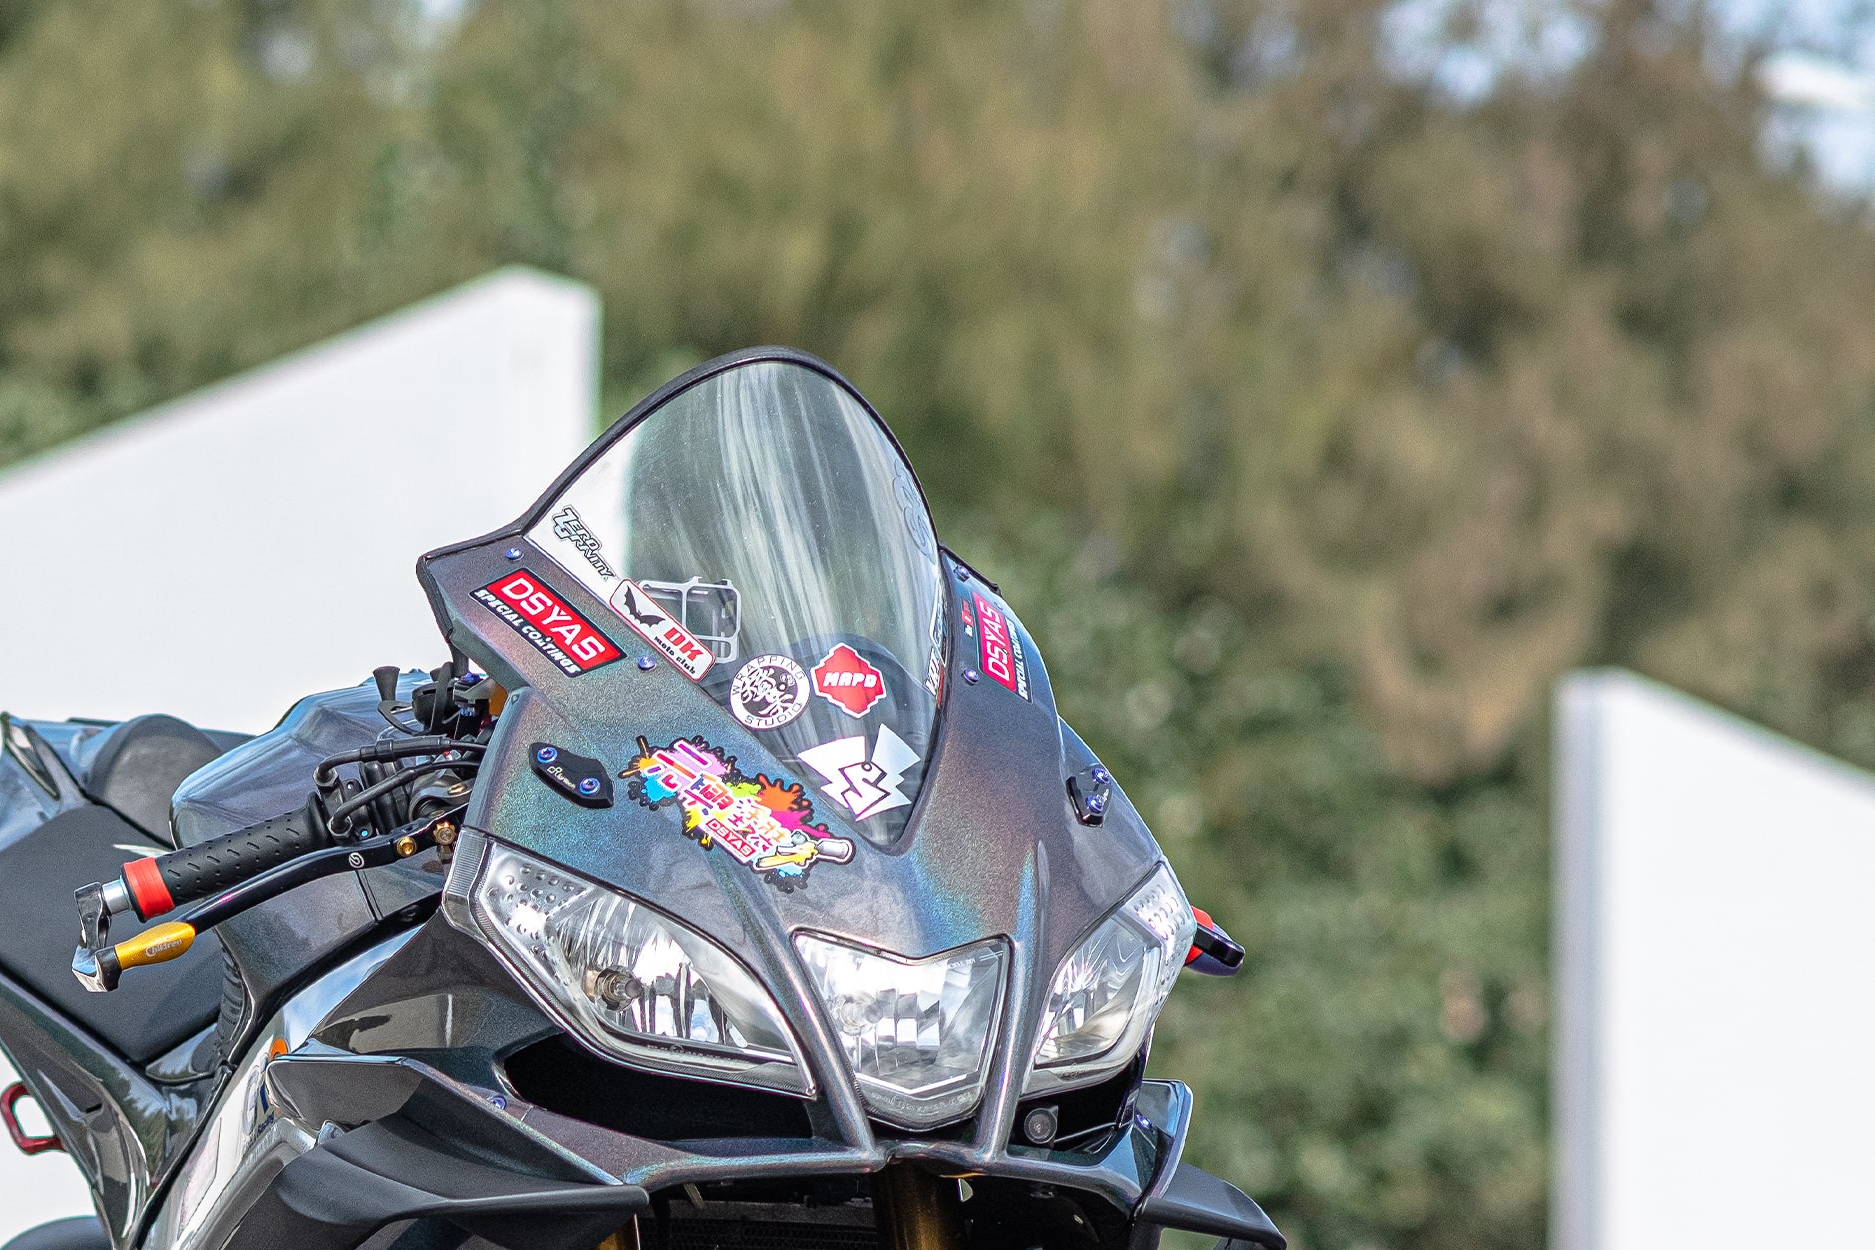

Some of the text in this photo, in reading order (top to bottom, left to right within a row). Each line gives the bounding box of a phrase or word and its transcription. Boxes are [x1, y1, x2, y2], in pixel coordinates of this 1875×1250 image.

[553, 507, 600, 551] ZERO
[554, 525, 615, 577] GRAVITY
[474, 589, 525, 627] SPECIAL
[501, 578, 606, 661] DSYAS
[654, 636, 696, 675] moto club
[663, 627, 704, 662] DK
[979, 600, 1010, 682] DSYAS
[732, 656, 806, 696] WRAPPING
[744, 702, 804, 727] STUDIO
[708, 819, 756, 857] DSYAS
